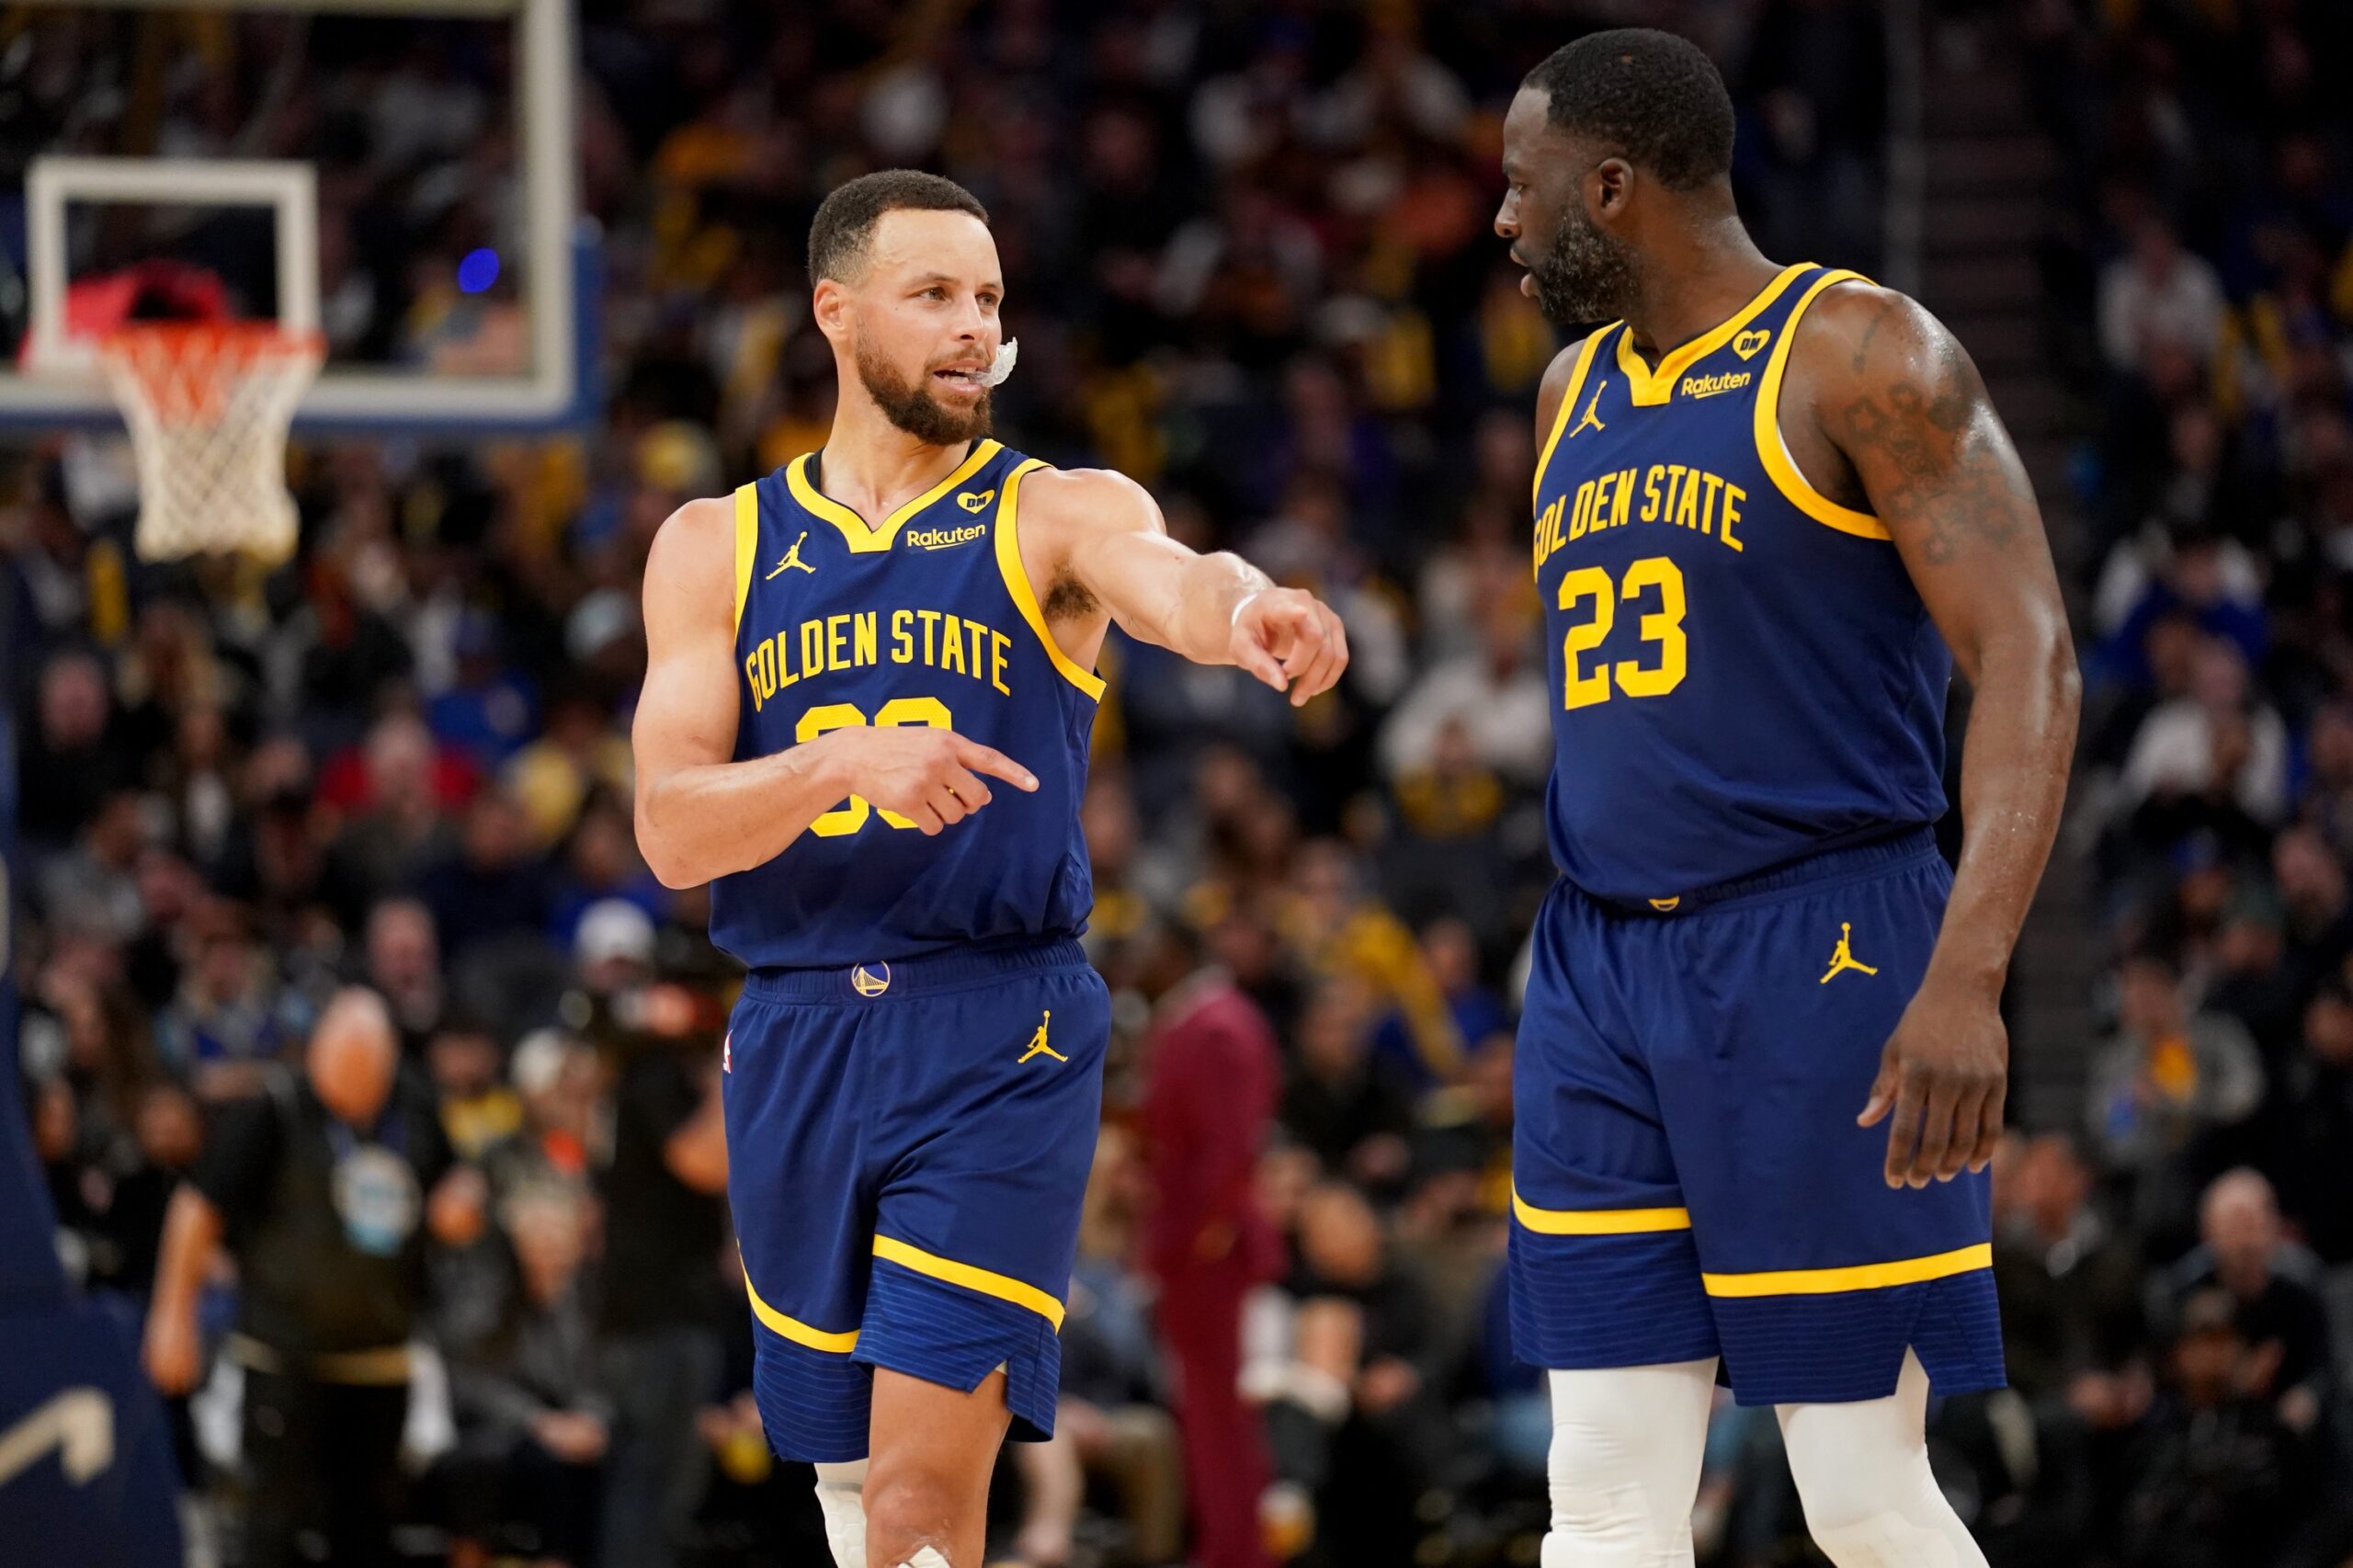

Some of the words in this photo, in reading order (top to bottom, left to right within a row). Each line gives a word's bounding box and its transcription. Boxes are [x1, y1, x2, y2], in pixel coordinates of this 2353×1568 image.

[1681, 372, 1751, 397] Rakuten
[966, 496, 987, 508] DM
[1641, 464, 1746, 552] STATE
[906, 524, 985, 548] Rakuten
[745, 611, 877, 712] GOLDEN
[891, 609, 1011, 697] STATE
[1558, 556, 1687, 710] 23
